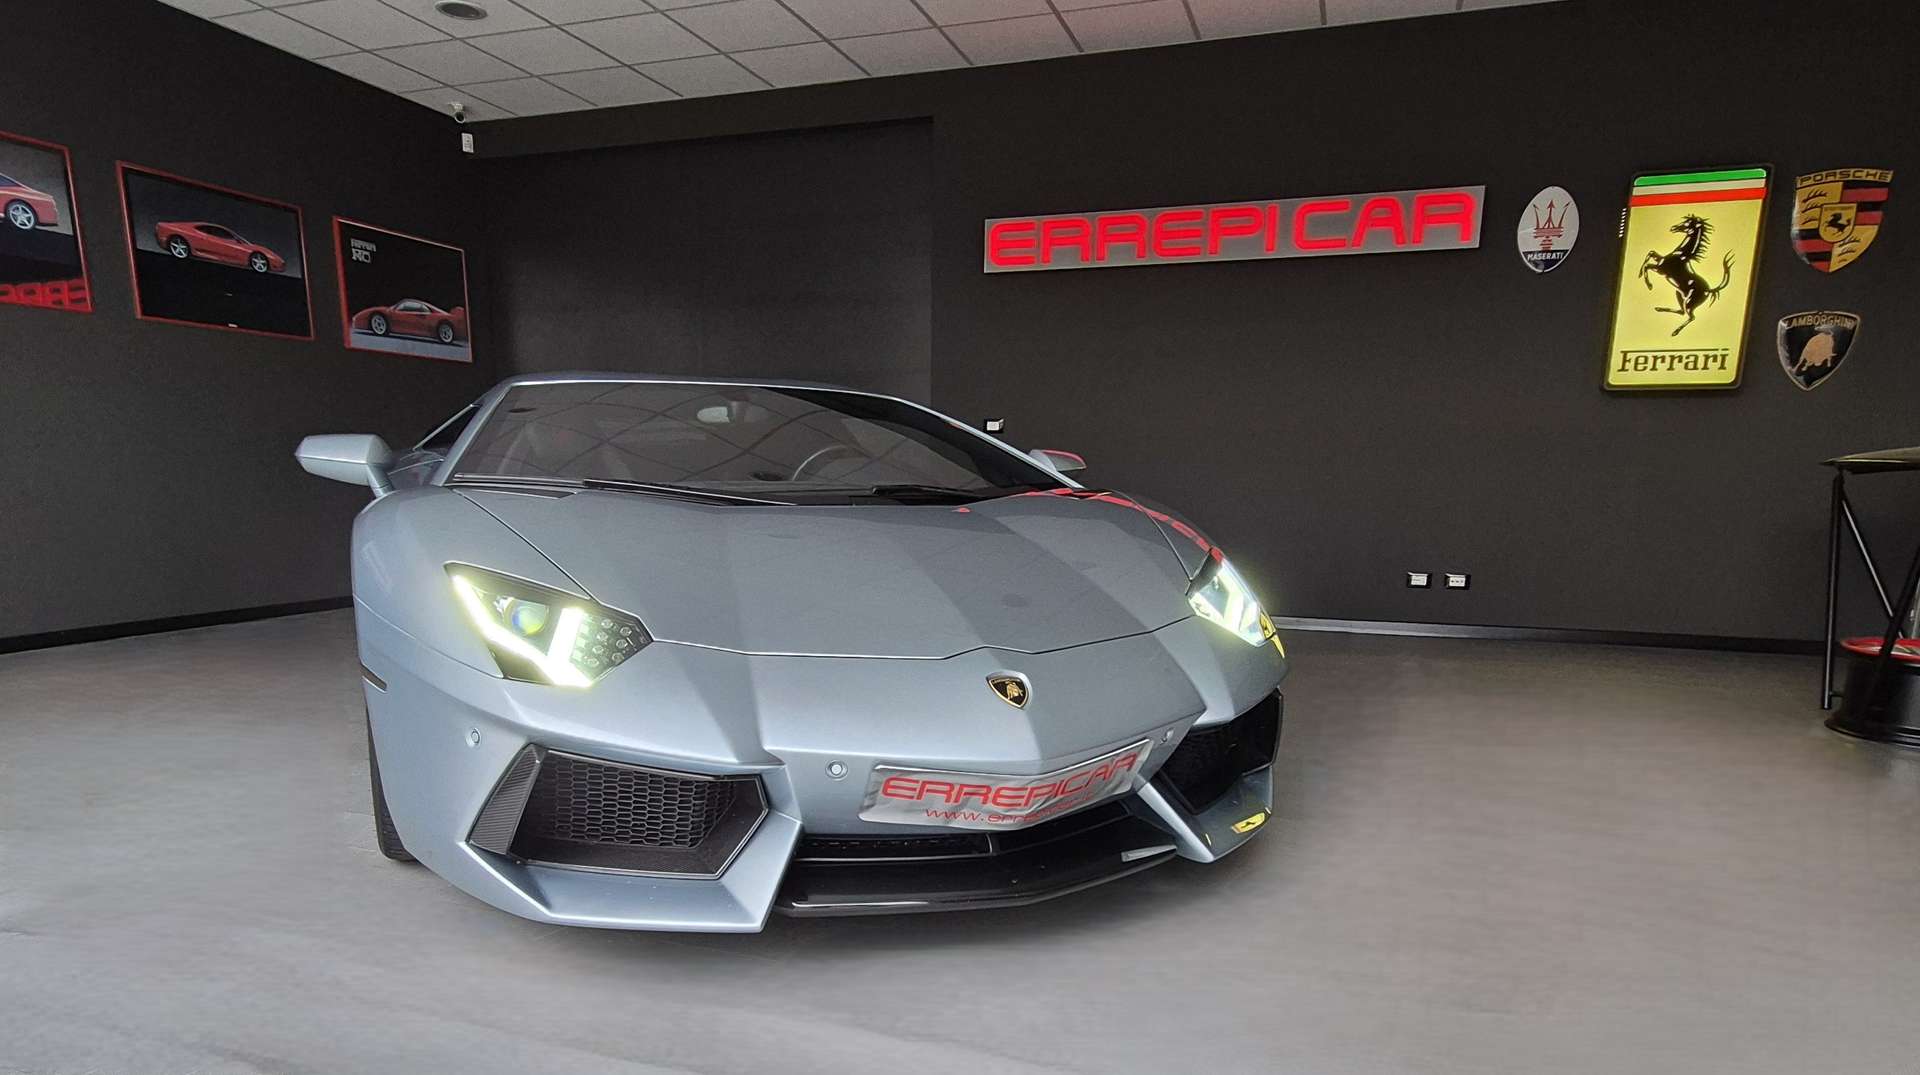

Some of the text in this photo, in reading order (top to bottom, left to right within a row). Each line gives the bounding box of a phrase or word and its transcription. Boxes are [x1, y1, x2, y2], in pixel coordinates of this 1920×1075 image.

[1800, 169, 1891, 185] PORSCHE
[1527, 252, 1564, 260] MASERATI
[1784, 314, 1856, 329] LAMBORGHINI
[1617, 348, 1729, 372] Ferrari
[880, 751, 1139, 808] ERREPICAR
